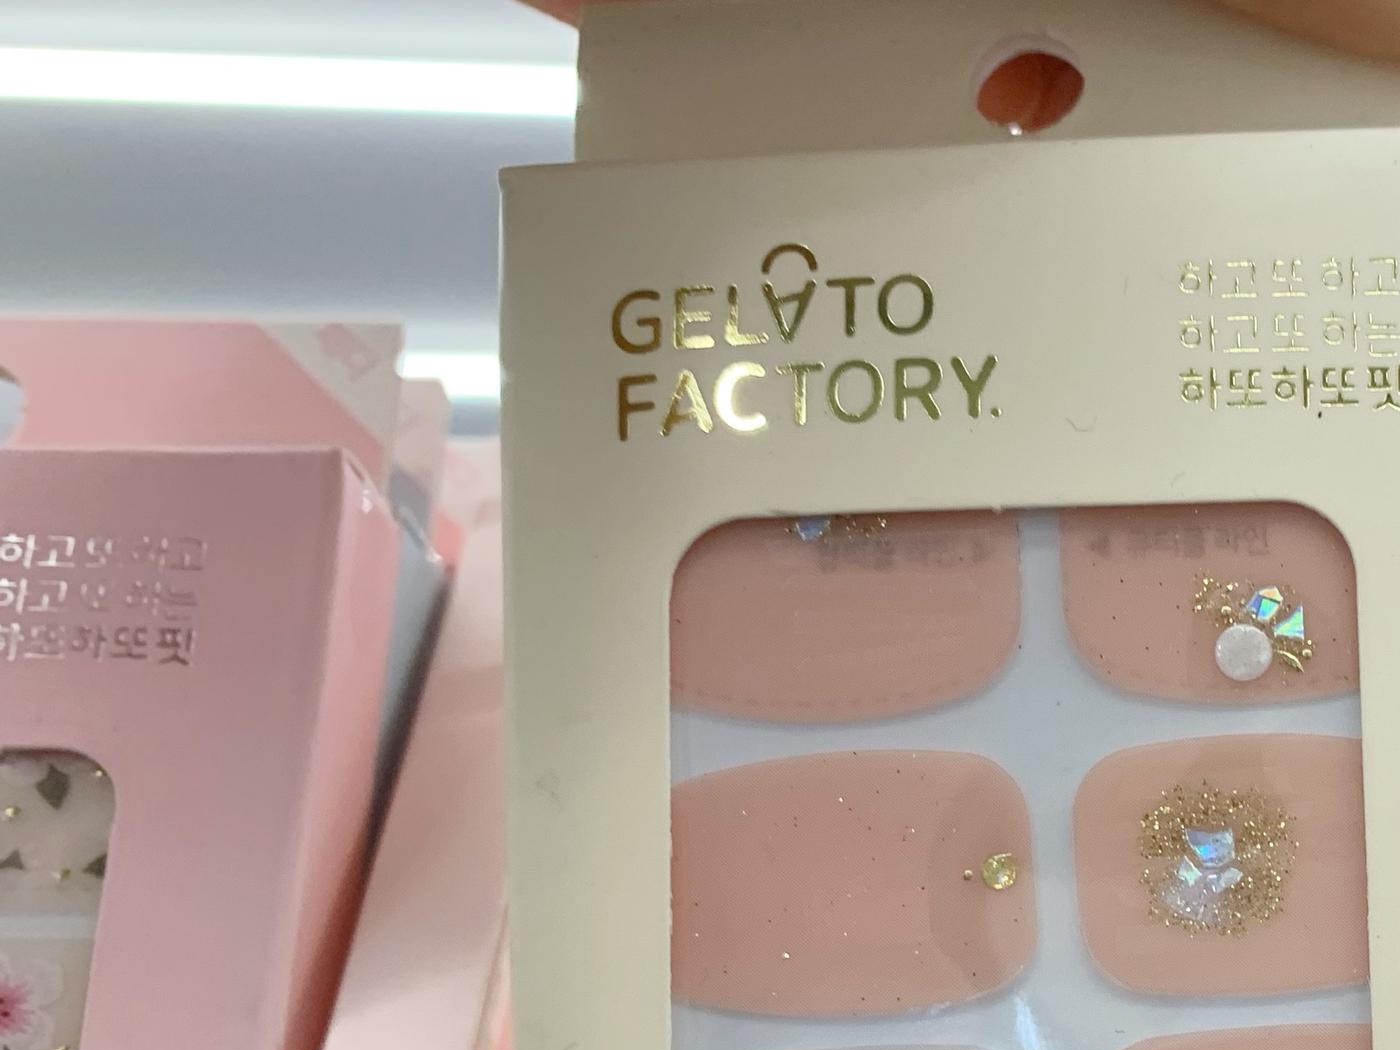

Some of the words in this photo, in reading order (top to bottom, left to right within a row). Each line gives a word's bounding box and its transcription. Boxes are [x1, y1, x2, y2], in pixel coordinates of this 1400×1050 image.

[1179, 259, 1257, 298] 하고
[1272, 259, 1309, 297] 또
[1321, 256, 1400, 297] 하고
[611, 243, 934, 354] GELATO
[1179, 314, 1259, 353] 하고
[1272, 314, 1309, 352] 또
